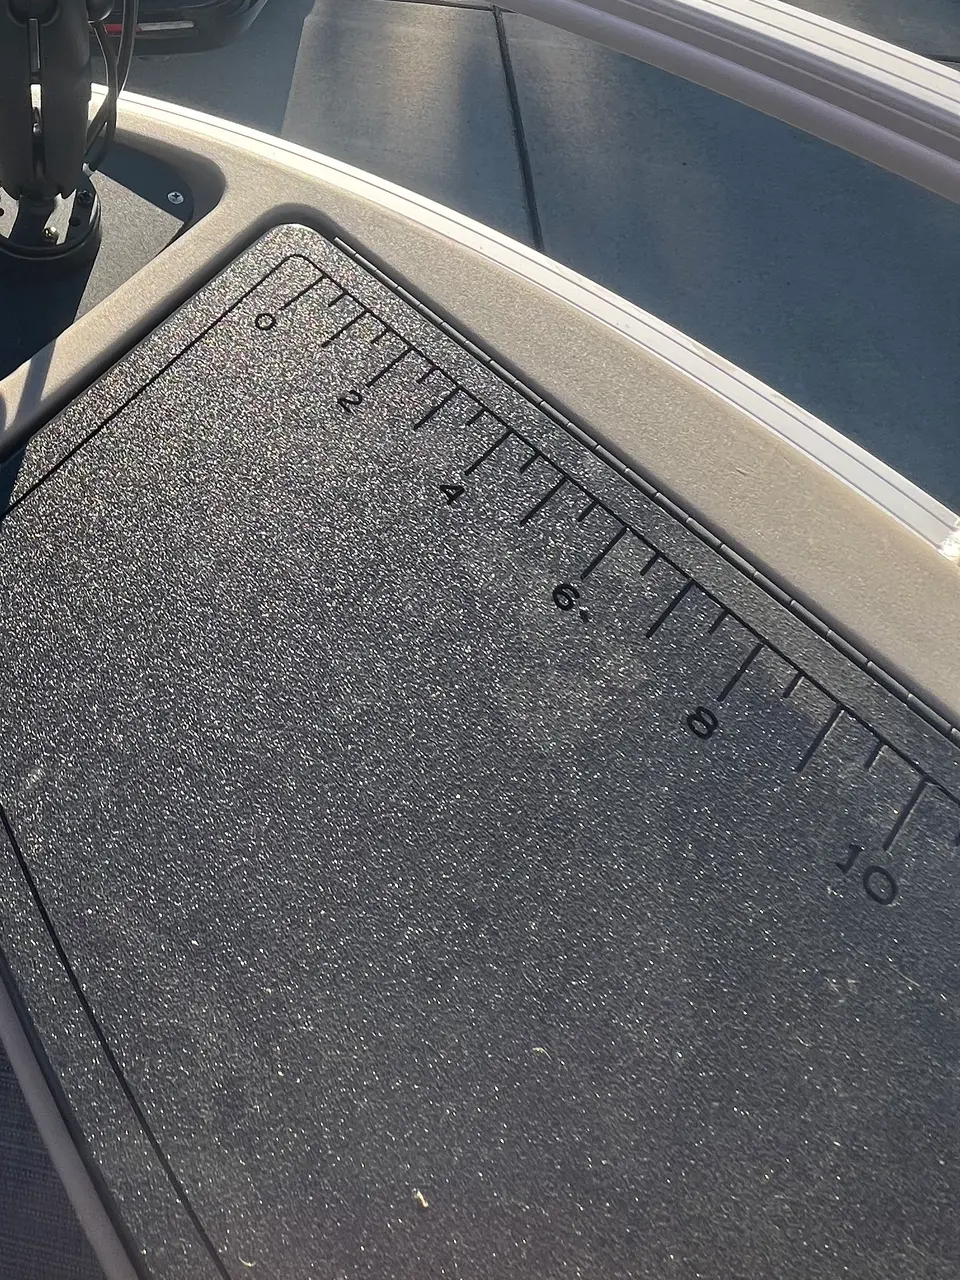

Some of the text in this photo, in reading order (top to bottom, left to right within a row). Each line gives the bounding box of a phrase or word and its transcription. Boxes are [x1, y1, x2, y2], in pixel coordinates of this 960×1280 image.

[254, 312, 277, 331] 0
[336, 388, 363, 413] 2
[440, 483, 465, 505] 4
[685, 705, 719, 740] 8
[836, 843, 897, 906] 10
